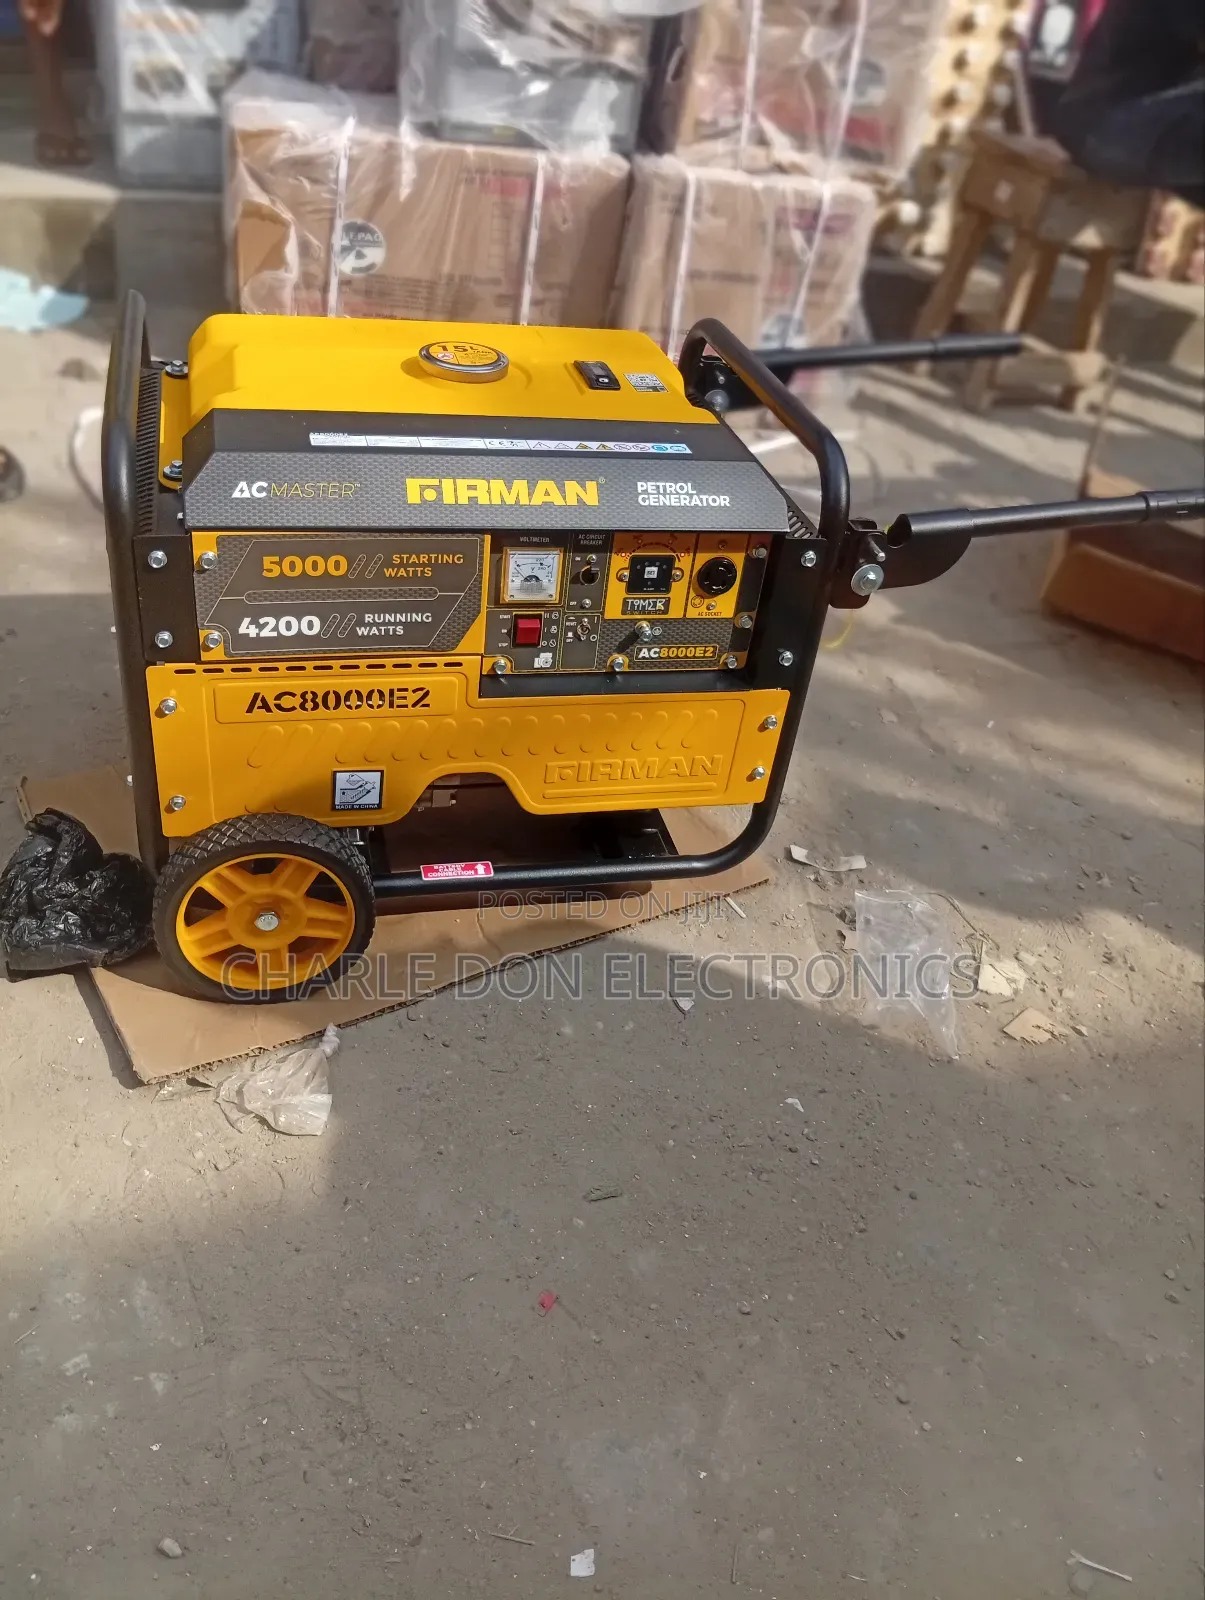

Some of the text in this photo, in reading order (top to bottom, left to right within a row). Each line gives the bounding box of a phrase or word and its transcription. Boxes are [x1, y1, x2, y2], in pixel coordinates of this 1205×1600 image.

[406, 478, 599, 506] FIRMAN
[637, 482, 696, 494] PETROL
[638, 495, 730, 507] GENERATOR
[392, 554, 464, 564] STARTING
[262, 555, 348, 577] 5000
[384, 567, 432, 577] WATTS
[365, 613, 432, 623] RUNNING
[238, 615, 321, 637] 4200
[356, 625, 404, 636] WATTS
[638, 647, 714, 658] AC8000E2
[245, 687, 431, 714] AC8000E2
[544, 755, 723, 784] FIRMAN
